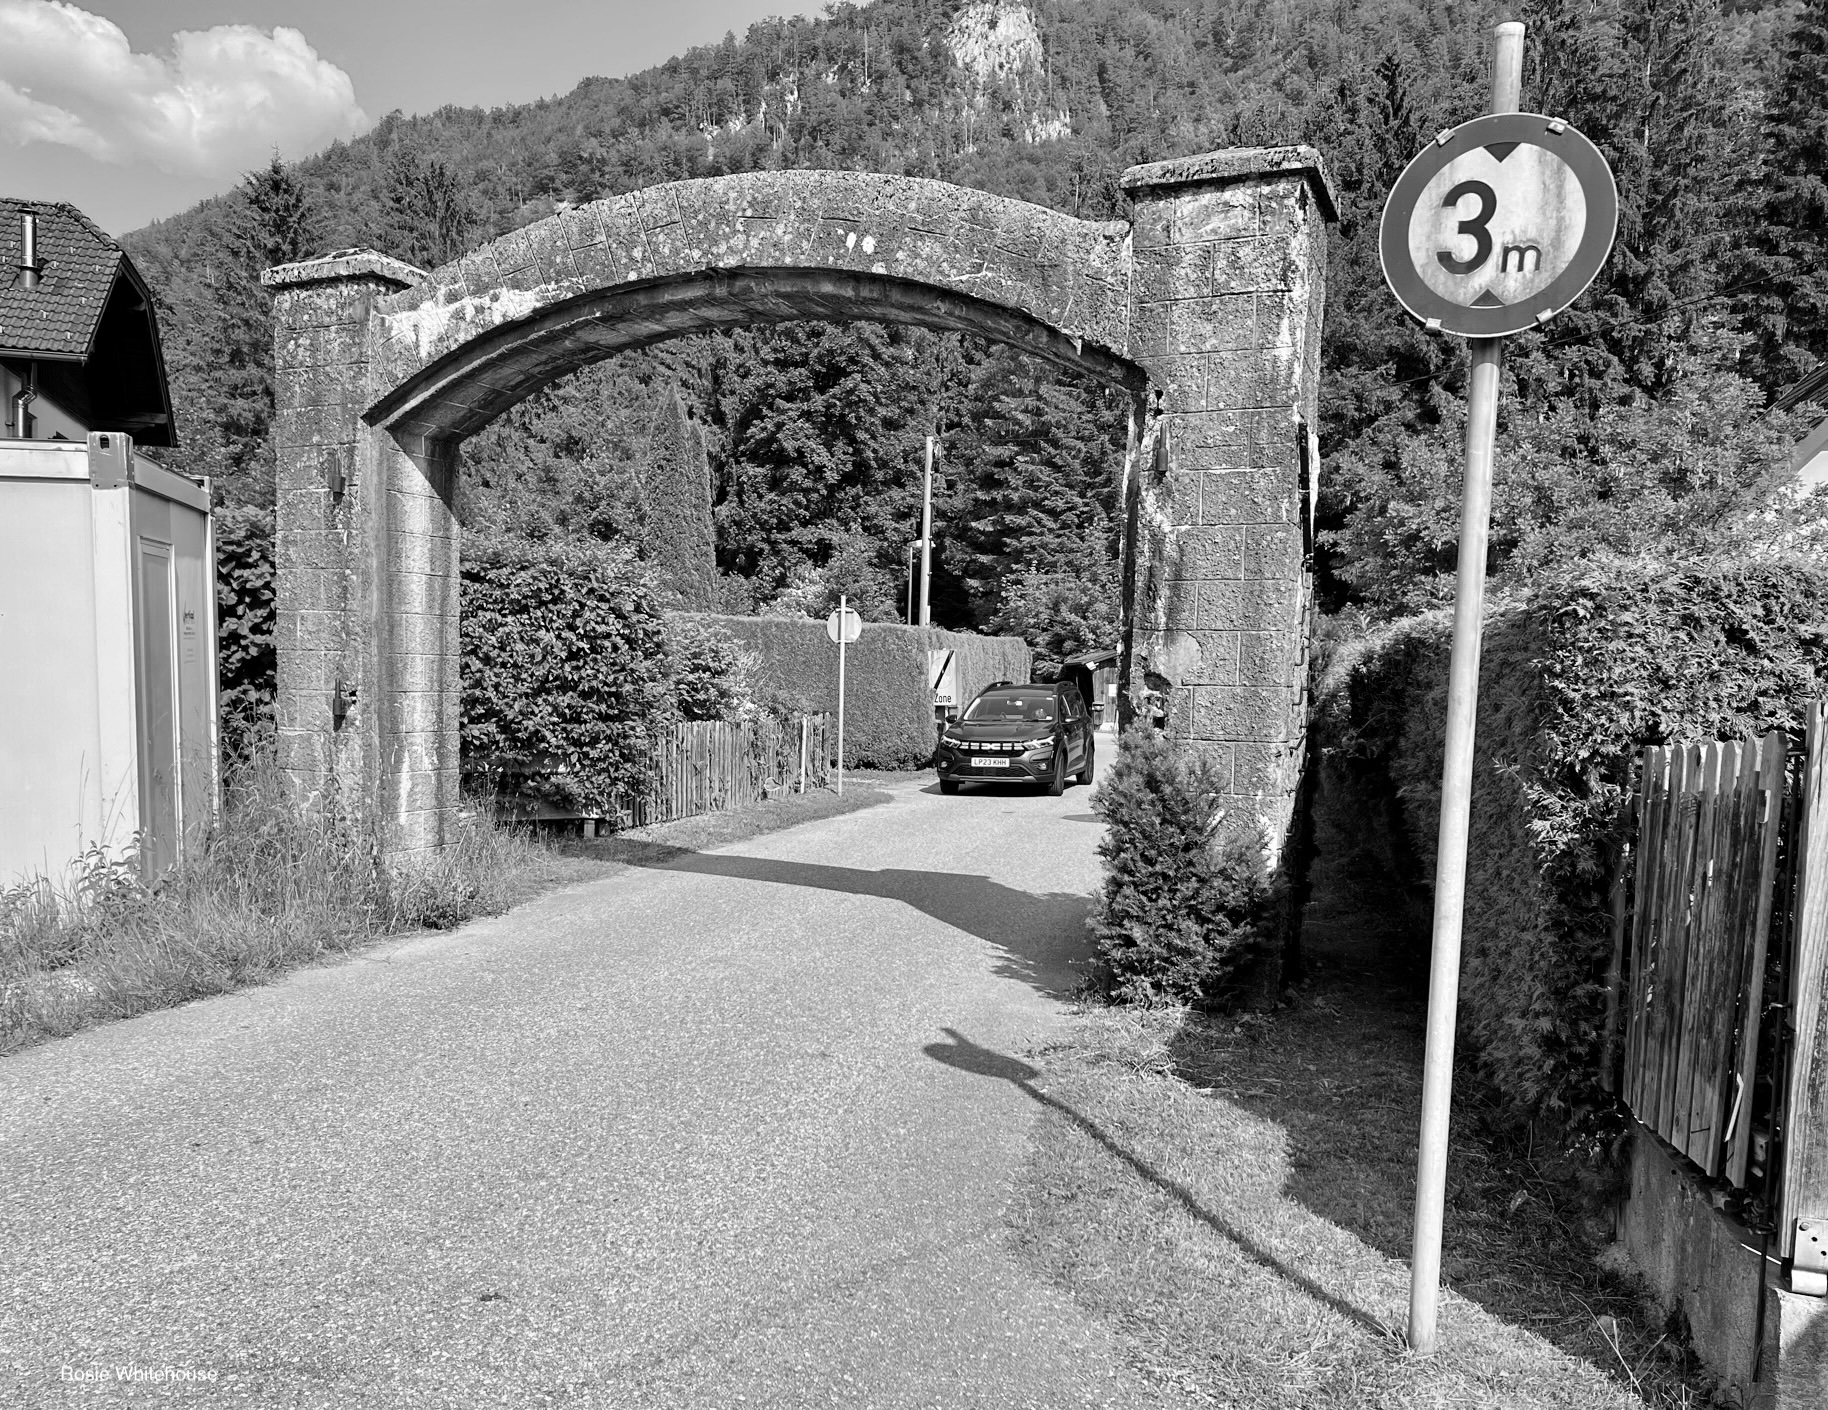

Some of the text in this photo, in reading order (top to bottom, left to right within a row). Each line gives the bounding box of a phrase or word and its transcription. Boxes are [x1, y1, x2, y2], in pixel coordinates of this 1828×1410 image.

[1436, 179, 1542, 275] 3 m
[934, 693, 952, 703] Zone
